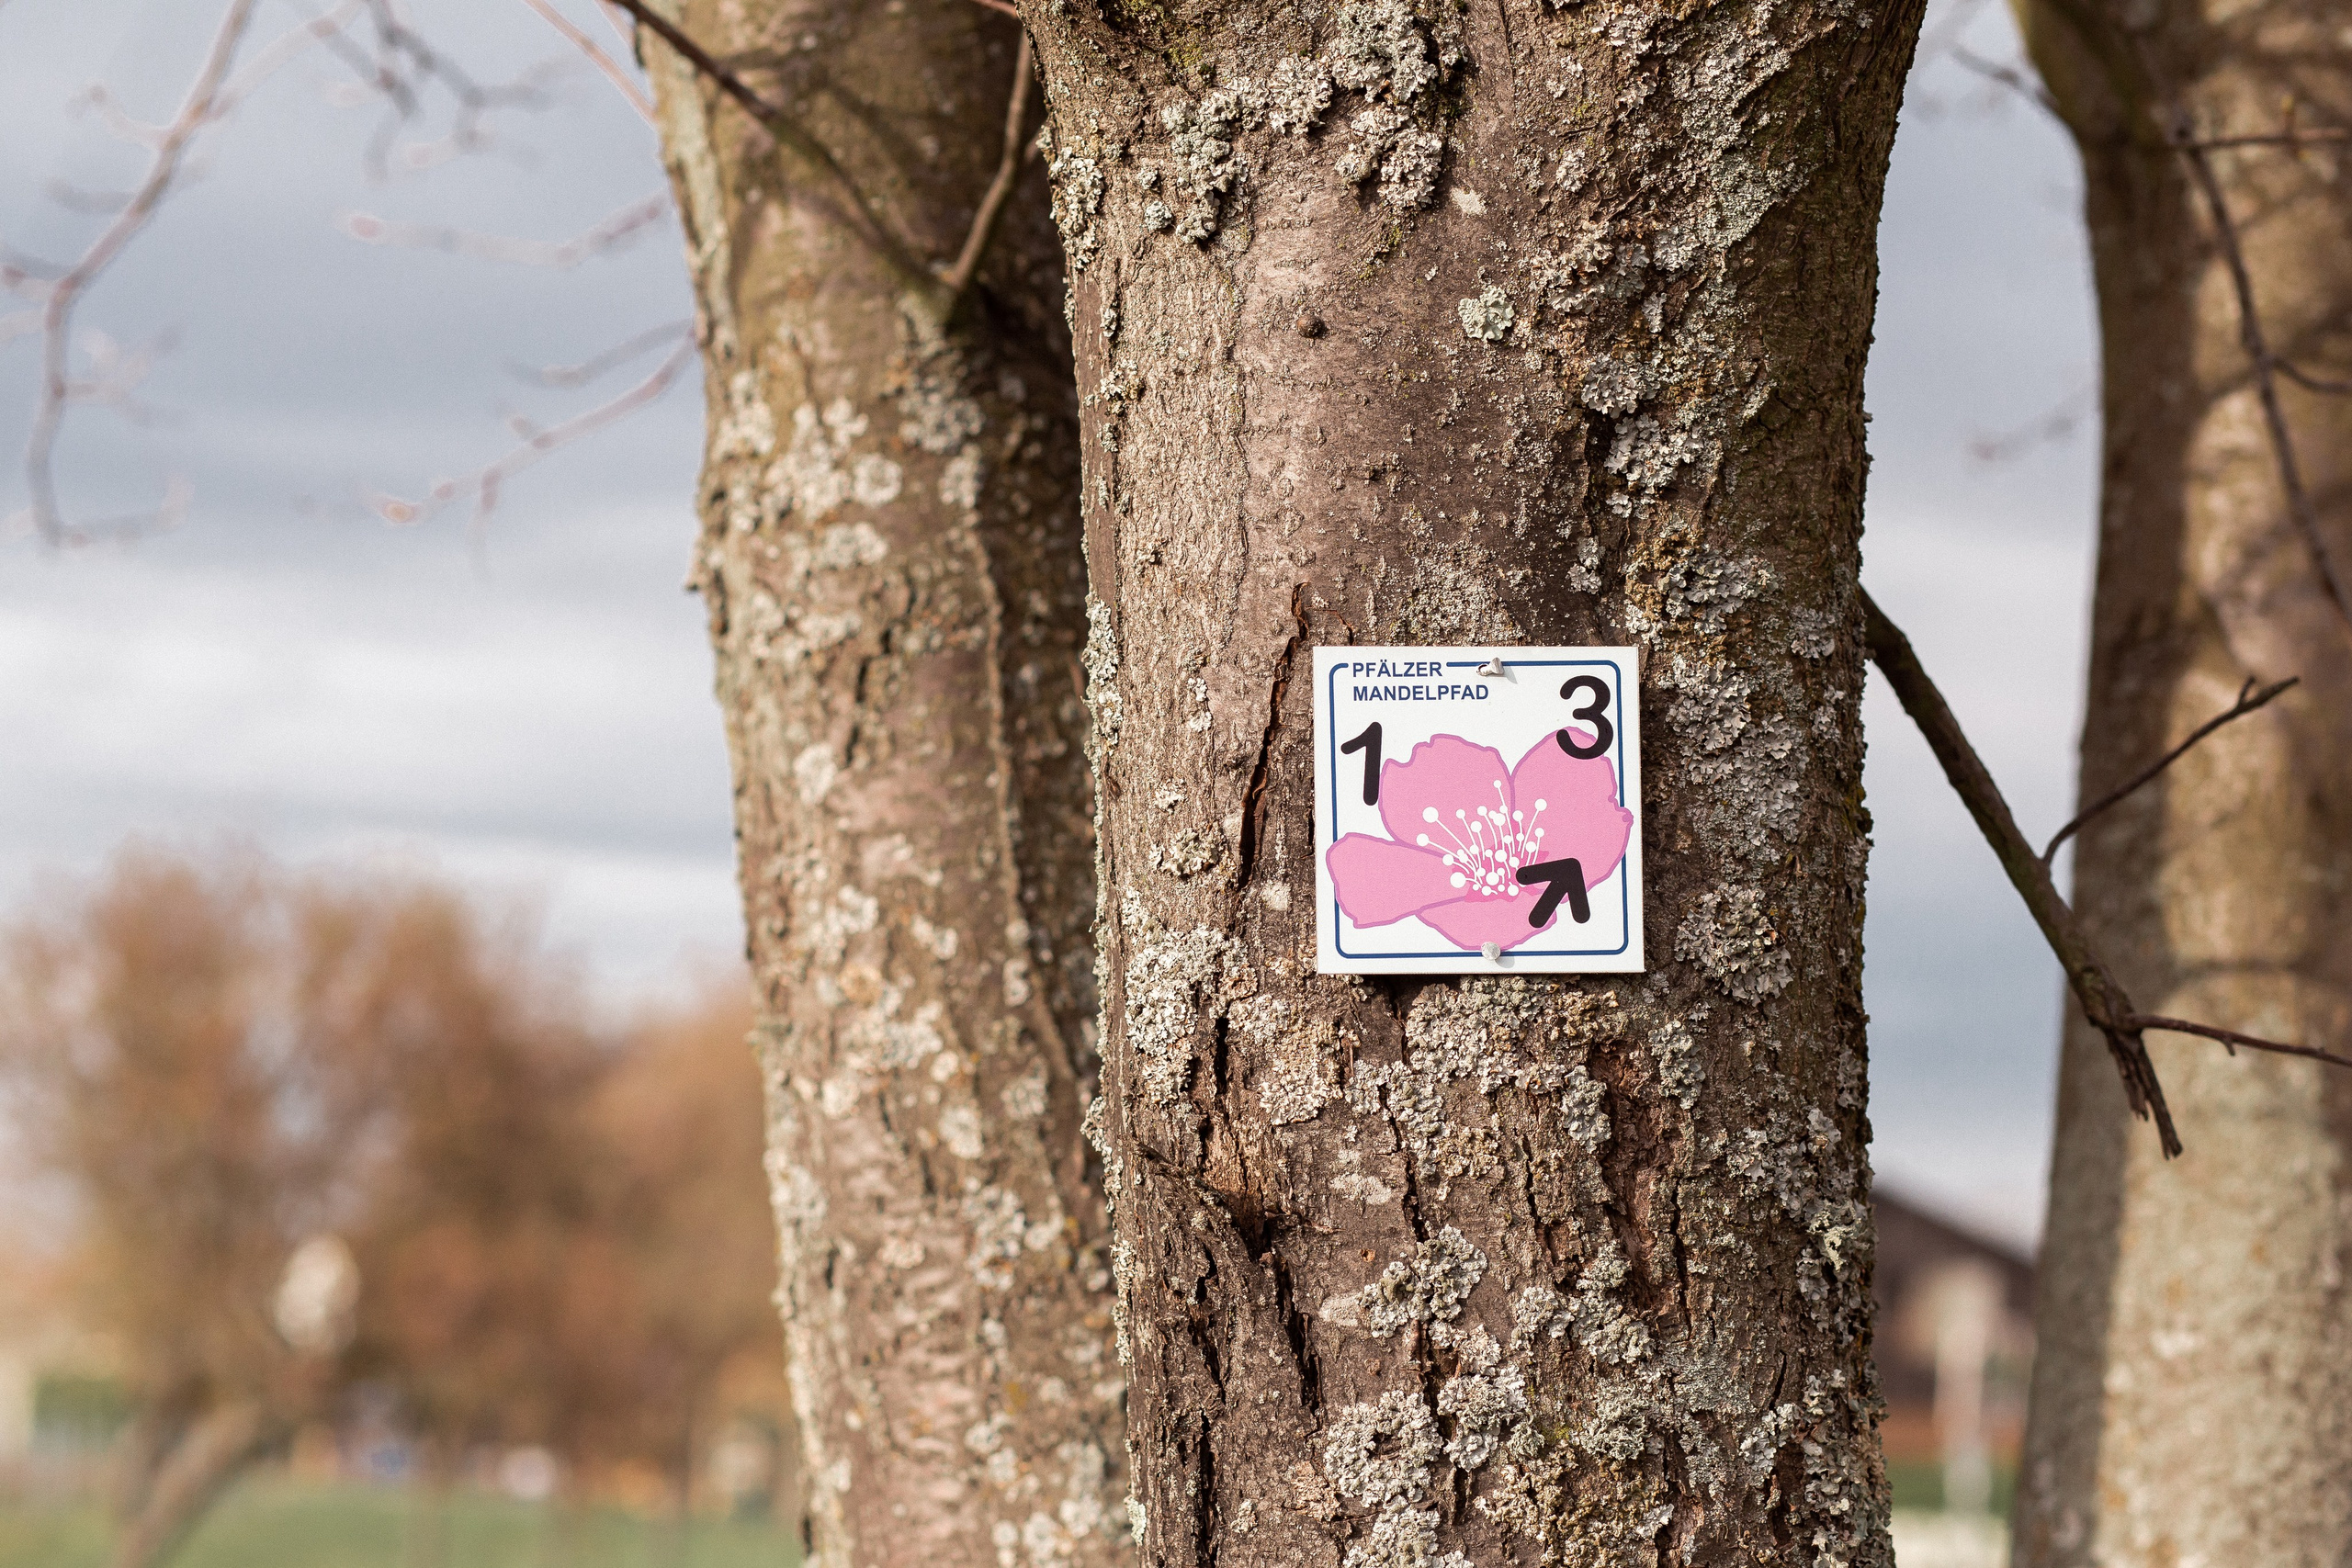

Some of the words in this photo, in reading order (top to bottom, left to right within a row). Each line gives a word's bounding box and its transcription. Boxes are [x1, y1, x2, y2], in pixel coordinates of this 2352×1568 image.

[1352, 661, 1442, 678] PFÄLZER
[1352, 684, 1489, 701] MANDELPFAD
[1556, 675, 1614, 760] 3
[1340, 721, 1383, 806] 1
